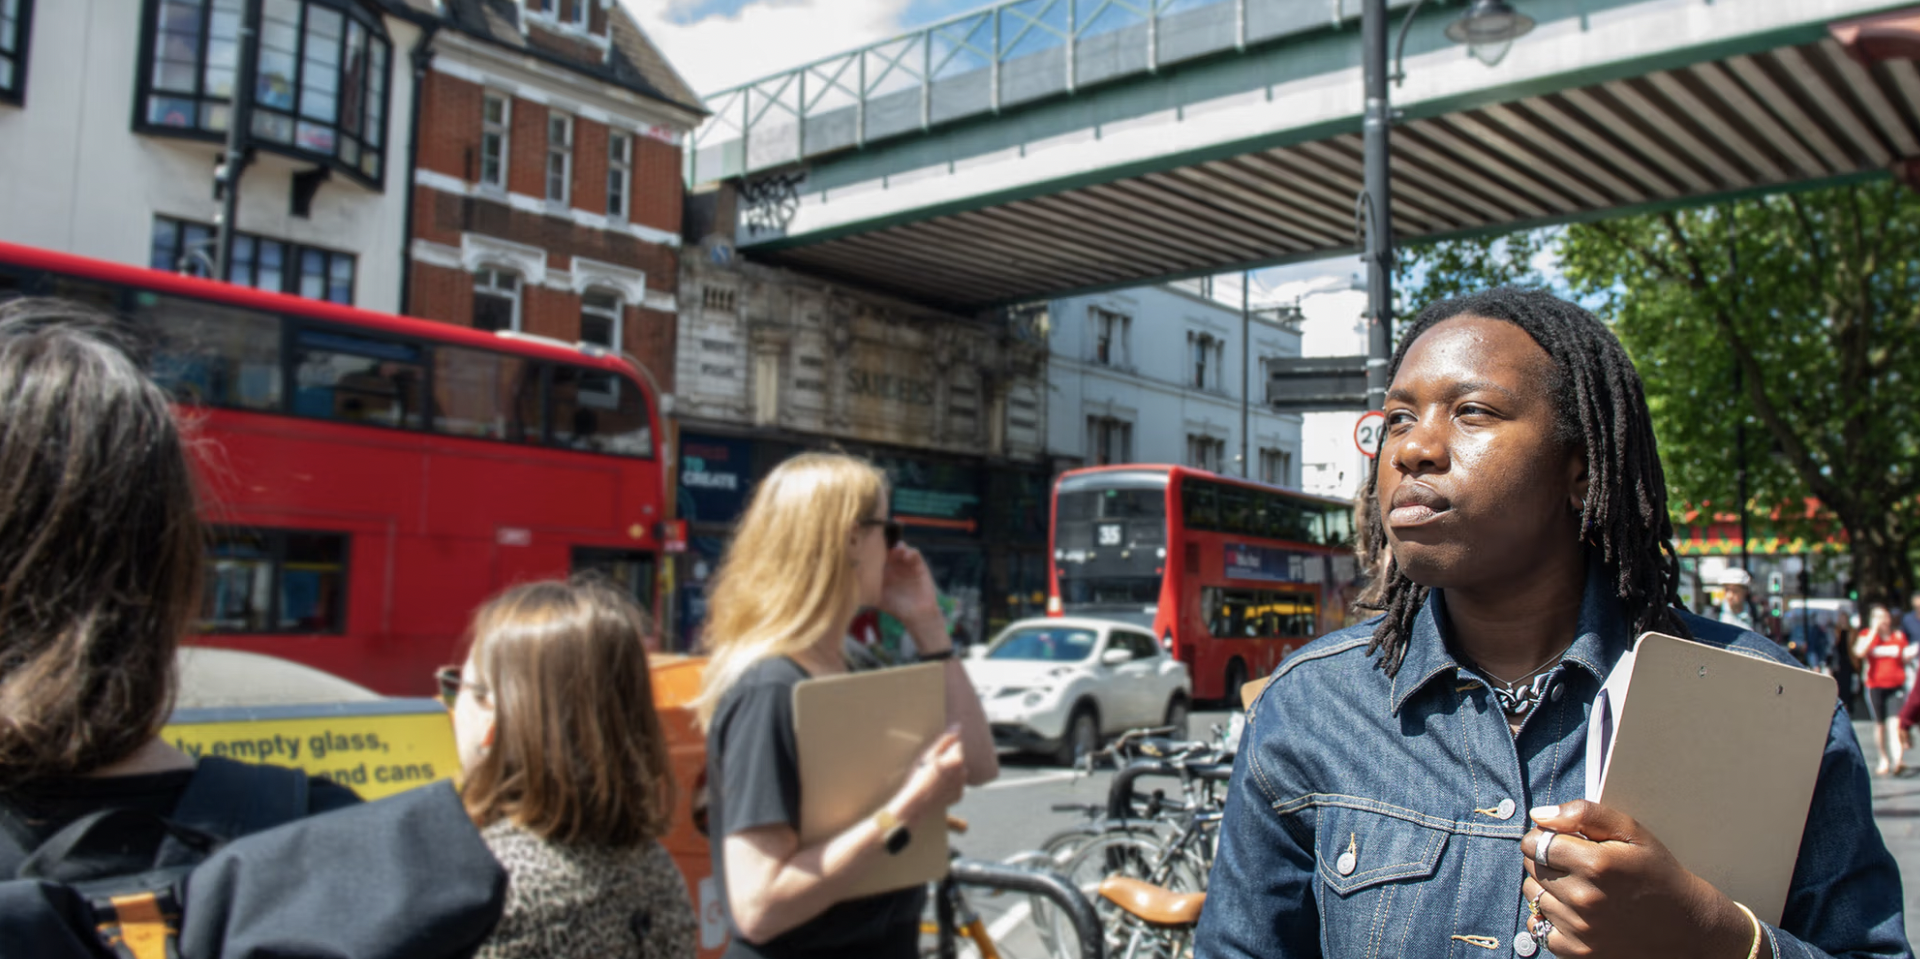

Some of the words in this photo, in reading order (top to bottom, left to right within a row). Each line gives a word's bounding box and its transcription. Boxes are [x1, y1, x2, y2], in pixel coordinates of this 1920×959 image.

[683, 456, 705, 472] TO
[681, 471, 737, 490] CREATE
[1098, 524, 1121, 545] 35
[212, 733, 301, 763] empty
[309, 729, 390, 758] glass,
[375, 763, 435, 783] cans
